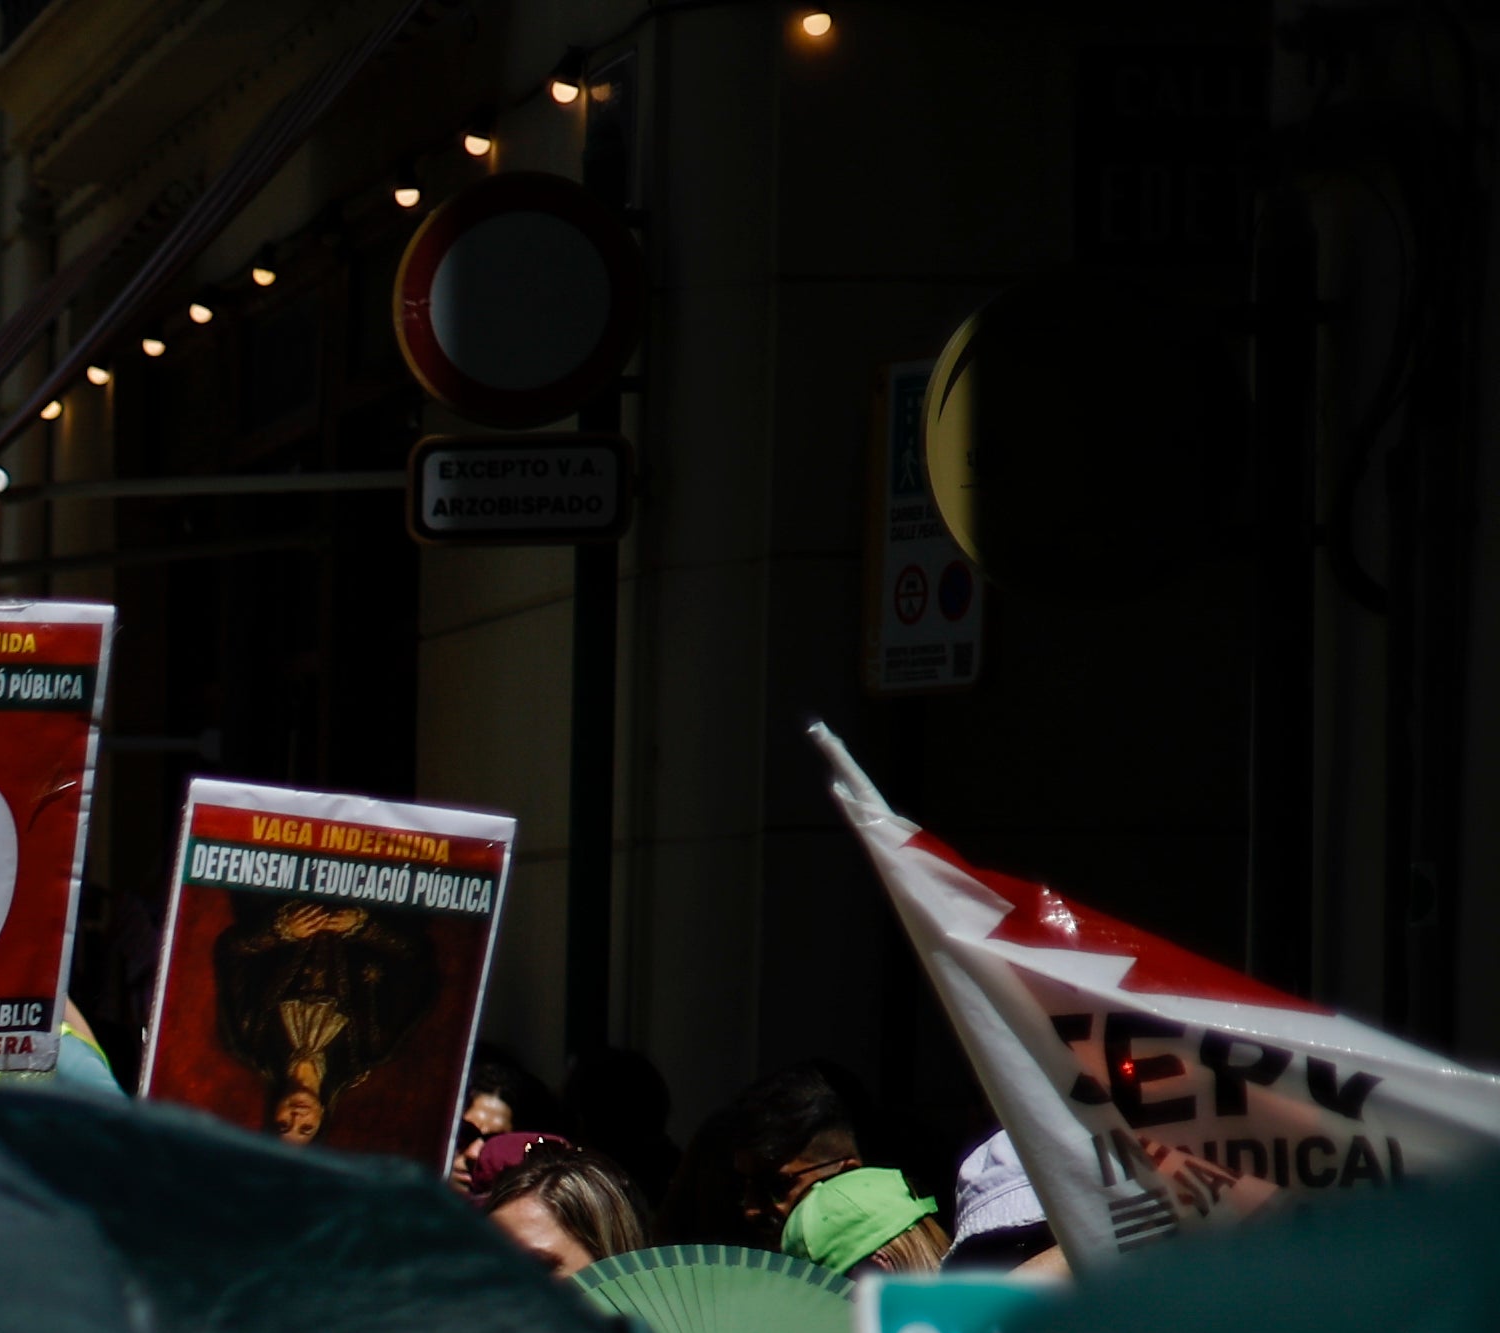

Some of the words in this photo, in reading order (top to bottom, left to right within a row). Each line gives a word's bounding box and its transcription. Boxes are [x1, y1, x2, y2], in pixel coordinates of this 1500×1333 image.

[439, 459, 549, 480] EXCEPTO
[432, 495, 603, 517] ARZOBISPADO
[8, 669, 81, 699] PÚBLICA
[252, 815, 312, 845] VAGA
[320, 824, 448, 862] INDEFINIDA
[190, 843, 297, 889] DEFENSEM
[299, 857, 410, 903] L'EDUCACIÓ
[411, 871, 491, 913] PÚBLICA
